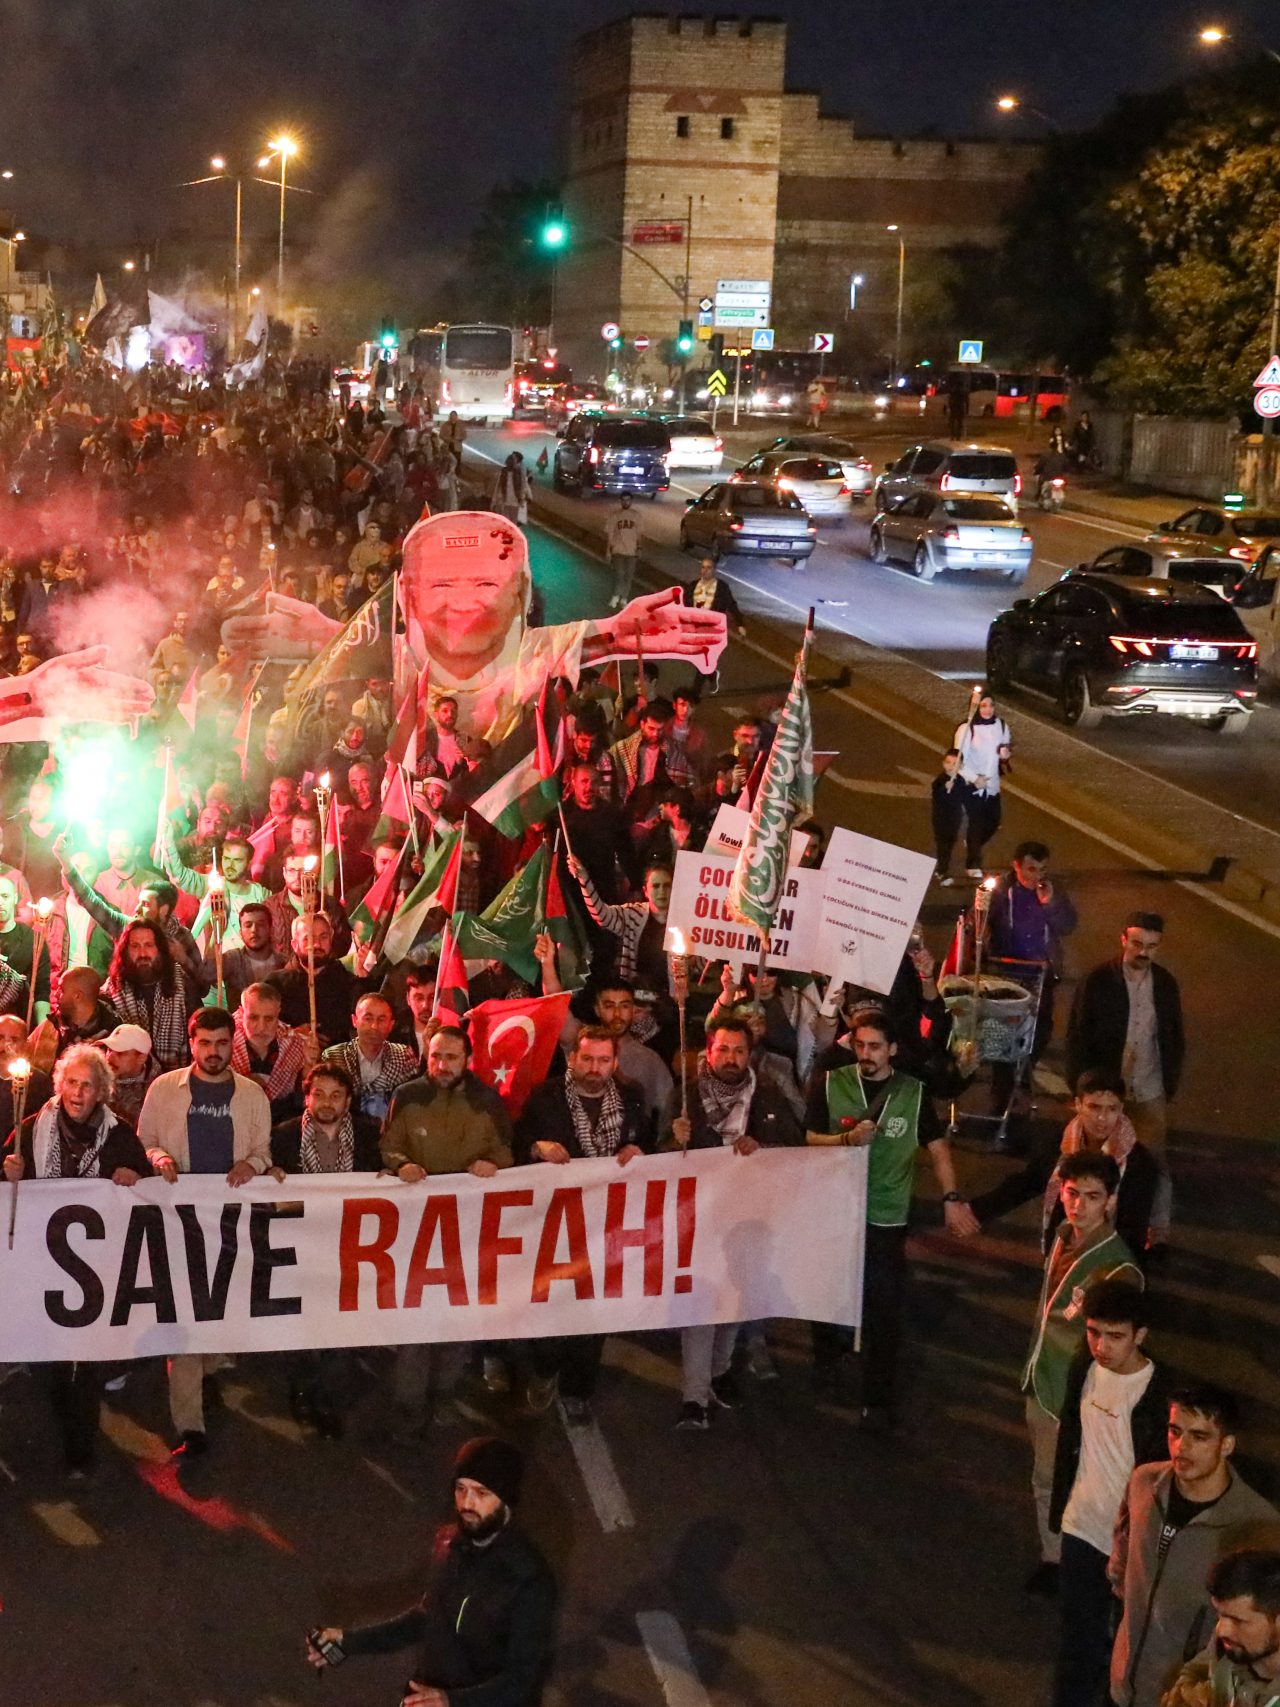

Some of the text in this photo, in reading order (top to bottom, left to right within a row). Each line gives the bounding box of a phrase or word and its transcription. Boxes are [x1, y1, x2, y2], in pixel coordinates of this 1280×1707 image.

[1262, 395, 1280, 409] 30
[617, 520, 635, 530] GAP
[44, 1177, 697, 1328] SAVE RAFAH!
